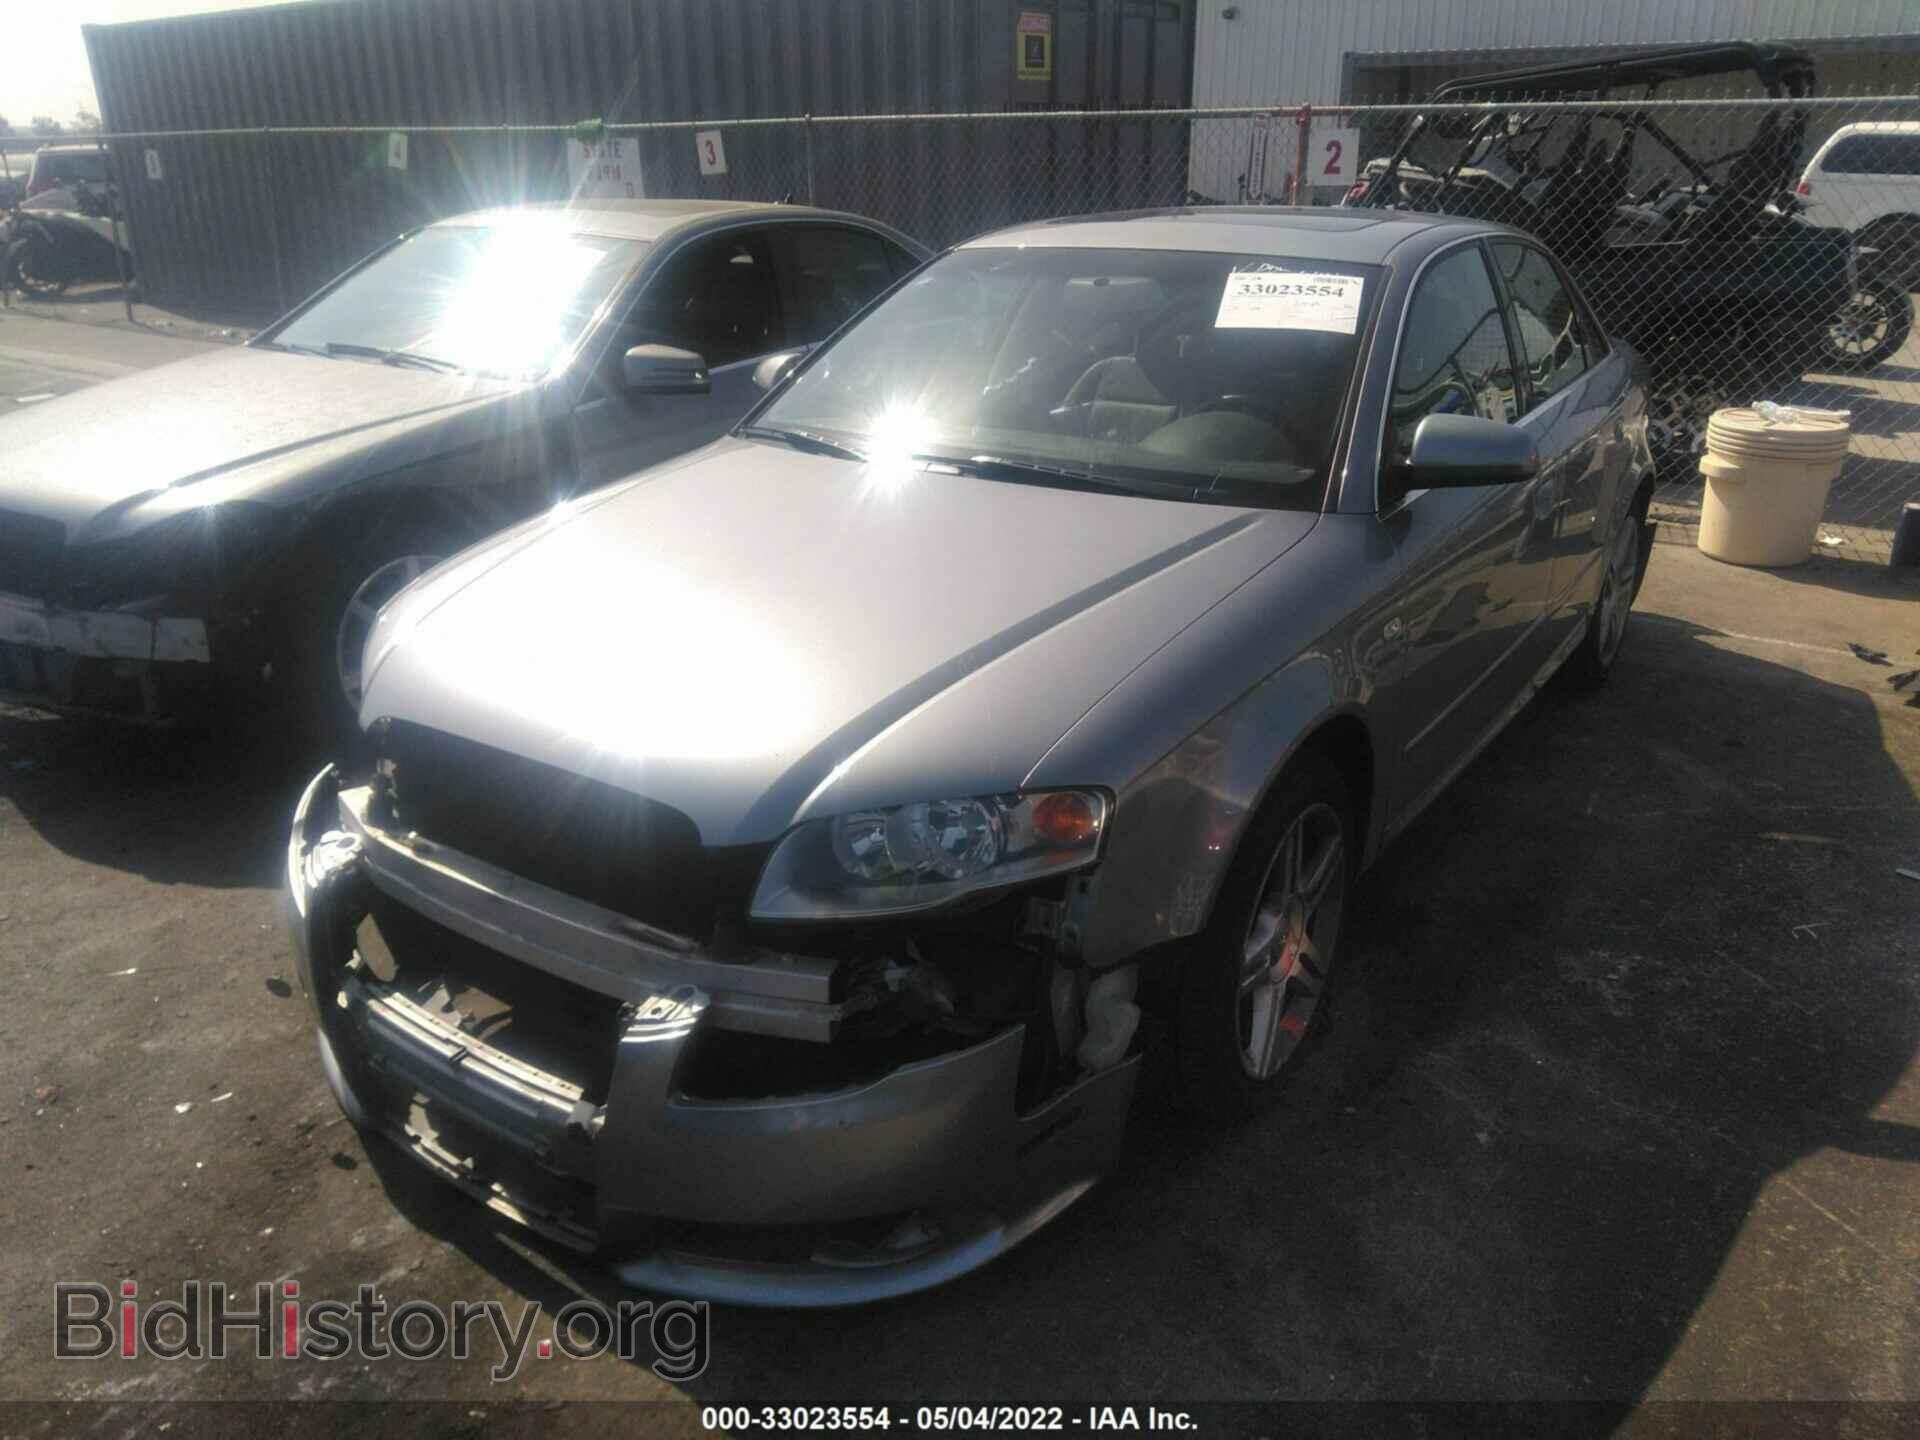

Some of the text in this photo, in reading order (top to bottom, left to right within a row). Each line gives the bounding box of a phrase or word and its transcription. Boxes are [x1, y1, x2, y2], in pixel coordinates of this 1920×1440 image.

[705, 139, 716, 166] 3
[1324, 140, 1342, 175] 2
[1238, 284, 1344, 298] 33023554
